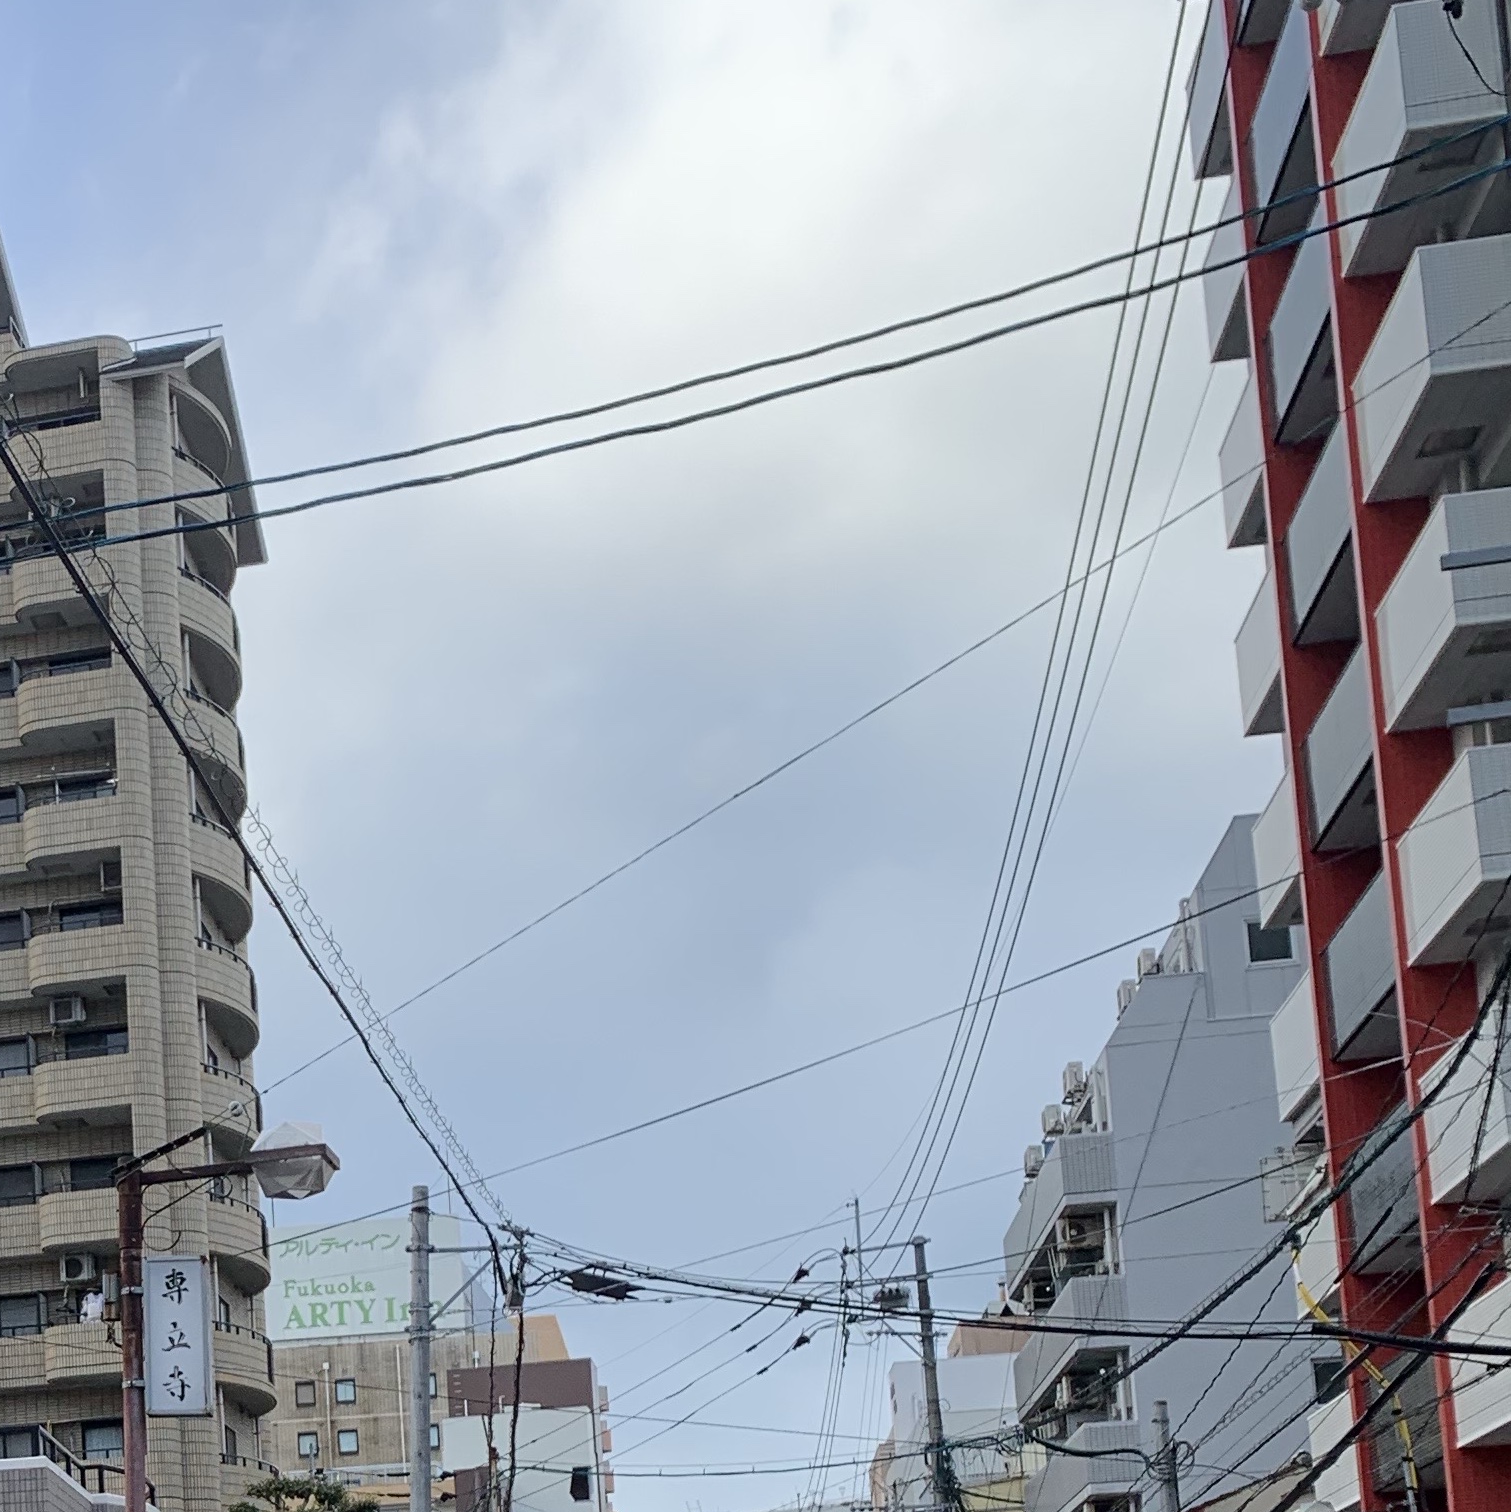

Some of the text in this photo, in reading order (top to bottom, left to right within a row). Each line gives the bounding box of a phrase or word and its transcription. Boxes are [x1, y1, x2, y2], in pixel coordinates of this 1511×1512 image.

[283, 1275, 376, 1298] Fukuoka
[283, 1298, 376, 1330] ARTY
[161, 1268, 191, 1402] 専立寺
